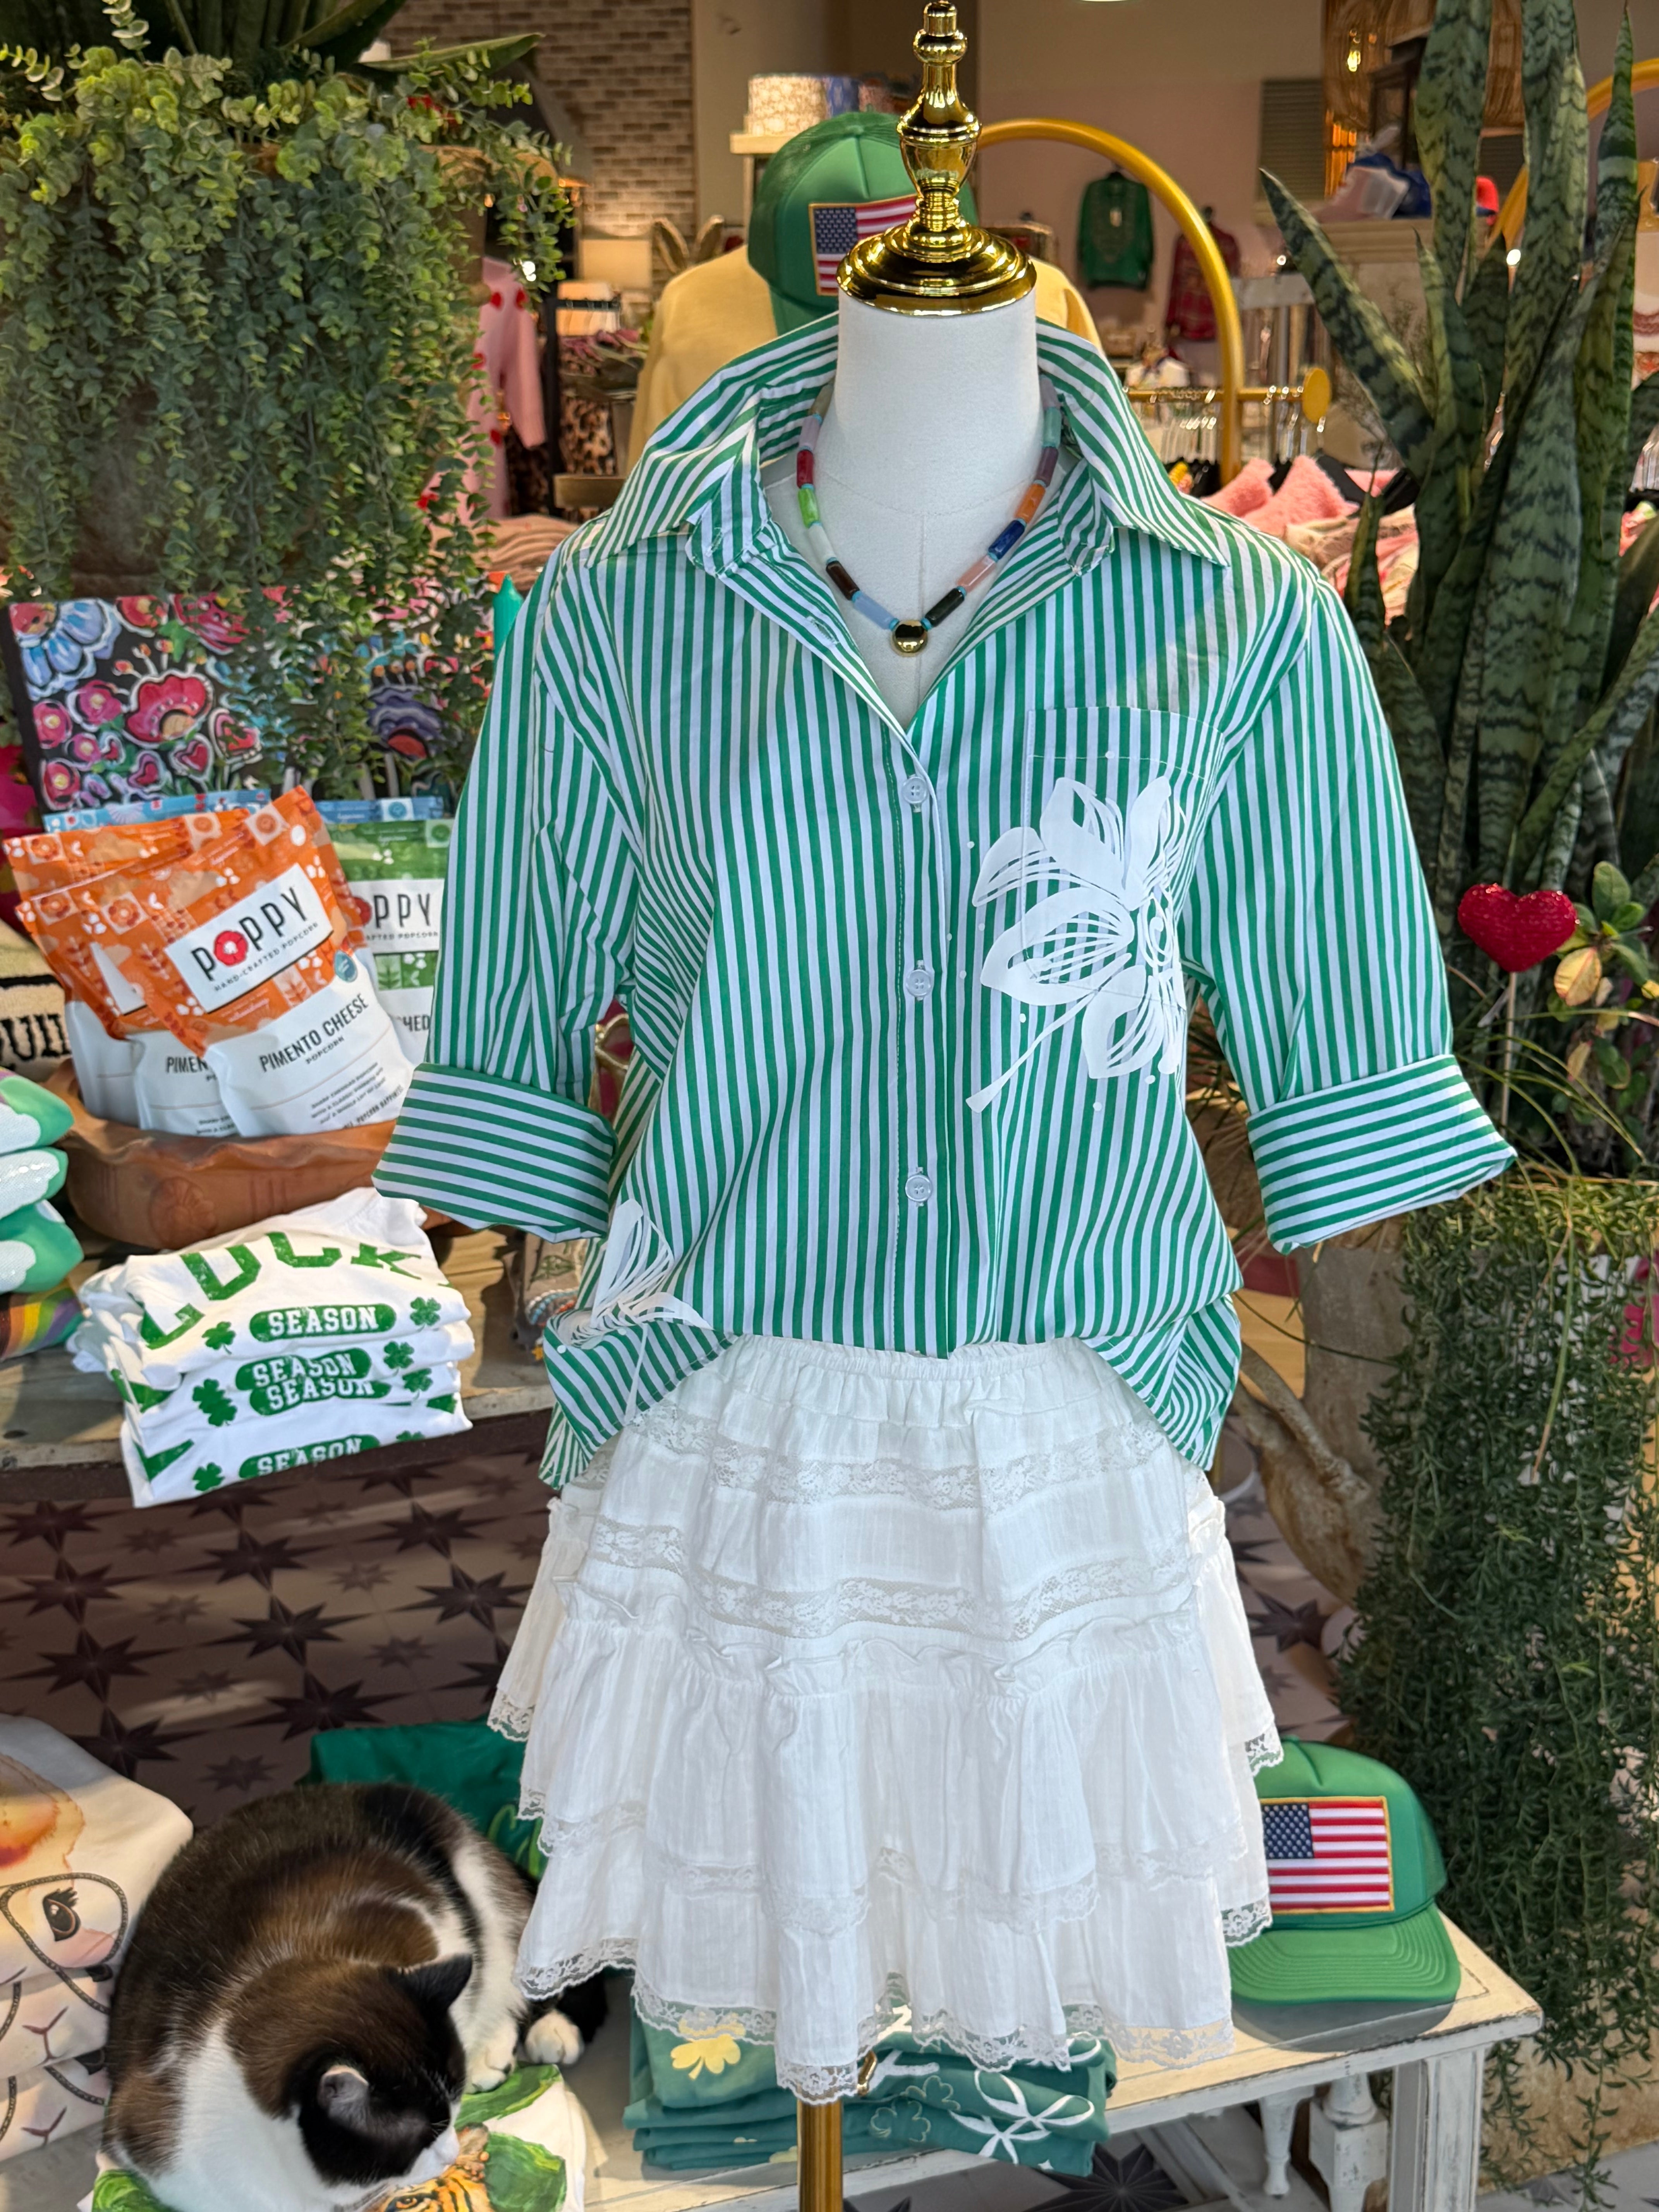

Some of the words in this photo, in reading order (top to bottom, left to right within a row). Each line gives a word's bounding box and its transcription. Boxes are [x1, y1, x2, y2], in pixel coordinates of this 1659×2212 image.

[354, 893, 430, 928] PPY
[259, 1029, 322, 1072] PIMENTO
[323, 993, 369, 1037] CHEESE
[165, 1056, 209, 1073] PIMEN
[305, 1036, 345, 1065] POPCORN
[268, 1306, 379, 1338] SEASON
[252, 1353, 357, 1387] SEASON
[266, 1377, 375, 1410] SEASON
[257, 1437, 362, 1476] SEASON
